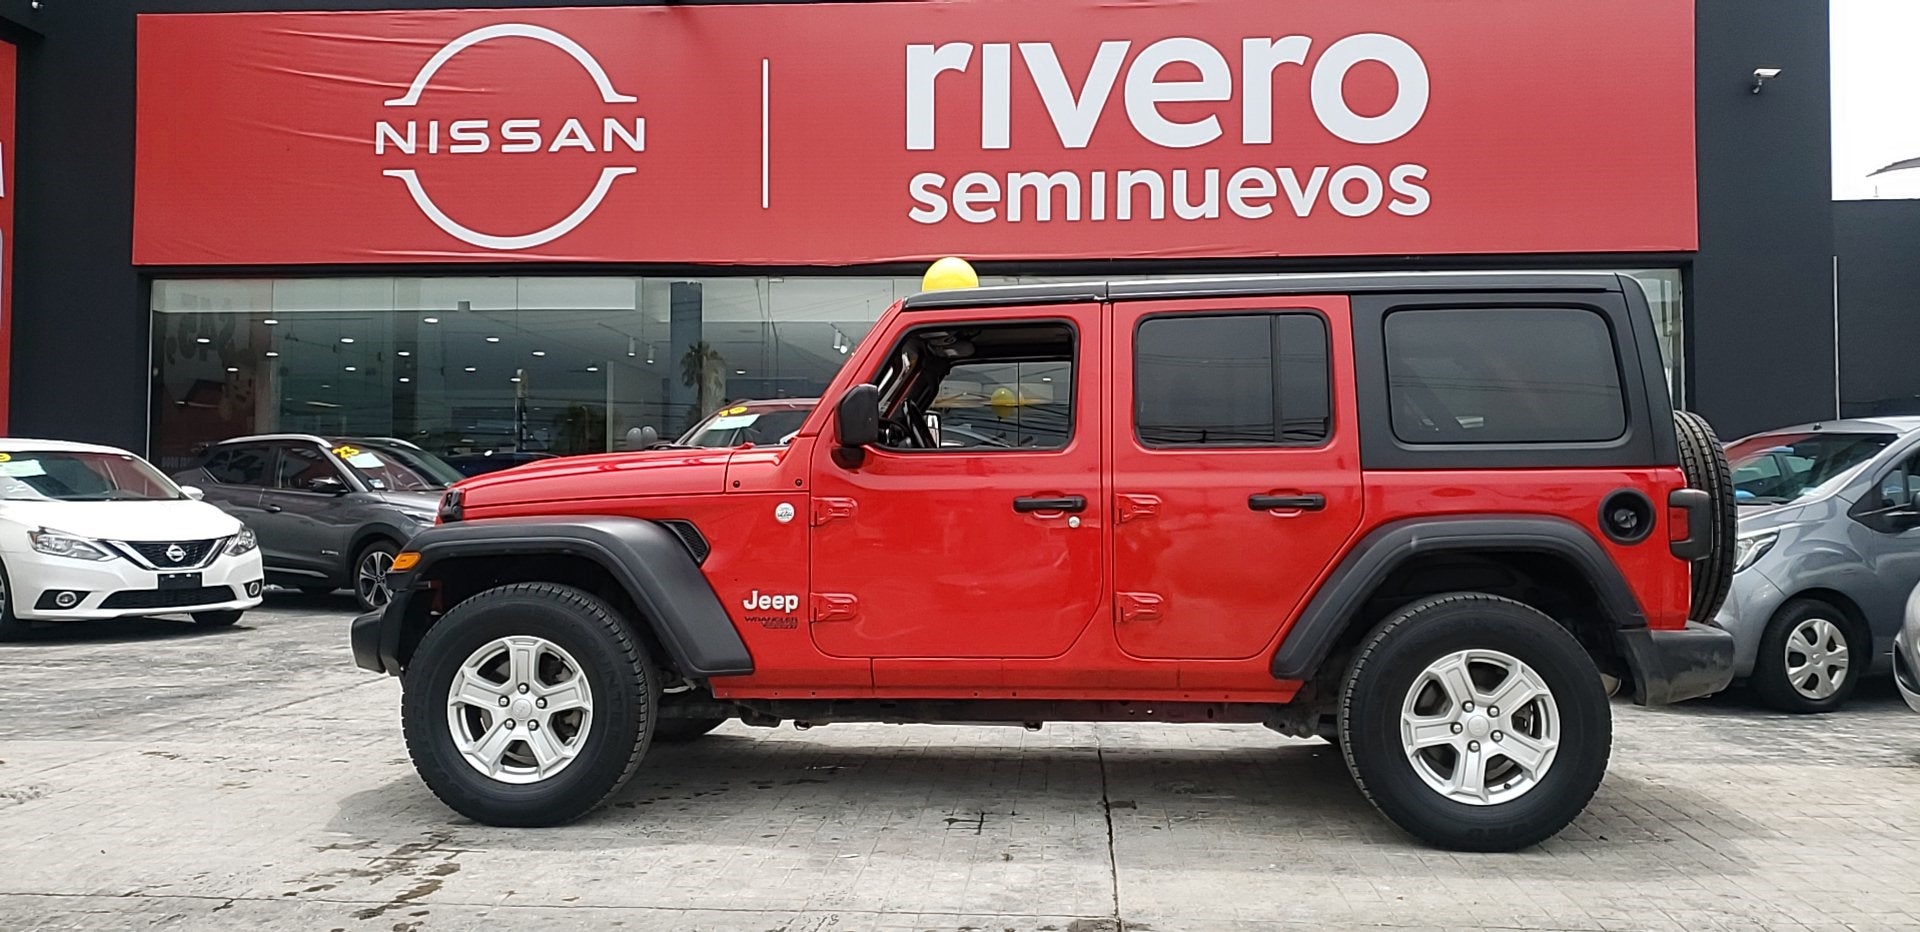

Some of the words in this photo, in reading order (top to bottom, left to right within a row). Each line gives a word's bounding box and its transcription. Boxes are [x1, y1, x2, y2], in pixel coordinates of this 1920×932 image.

[906, 32, 1430, 150] rivero
[375, 117, 645, 155] NISSAN
[908, 163, 1431, 224] seminuevos
[743, 590, 799, 613] Jeep
